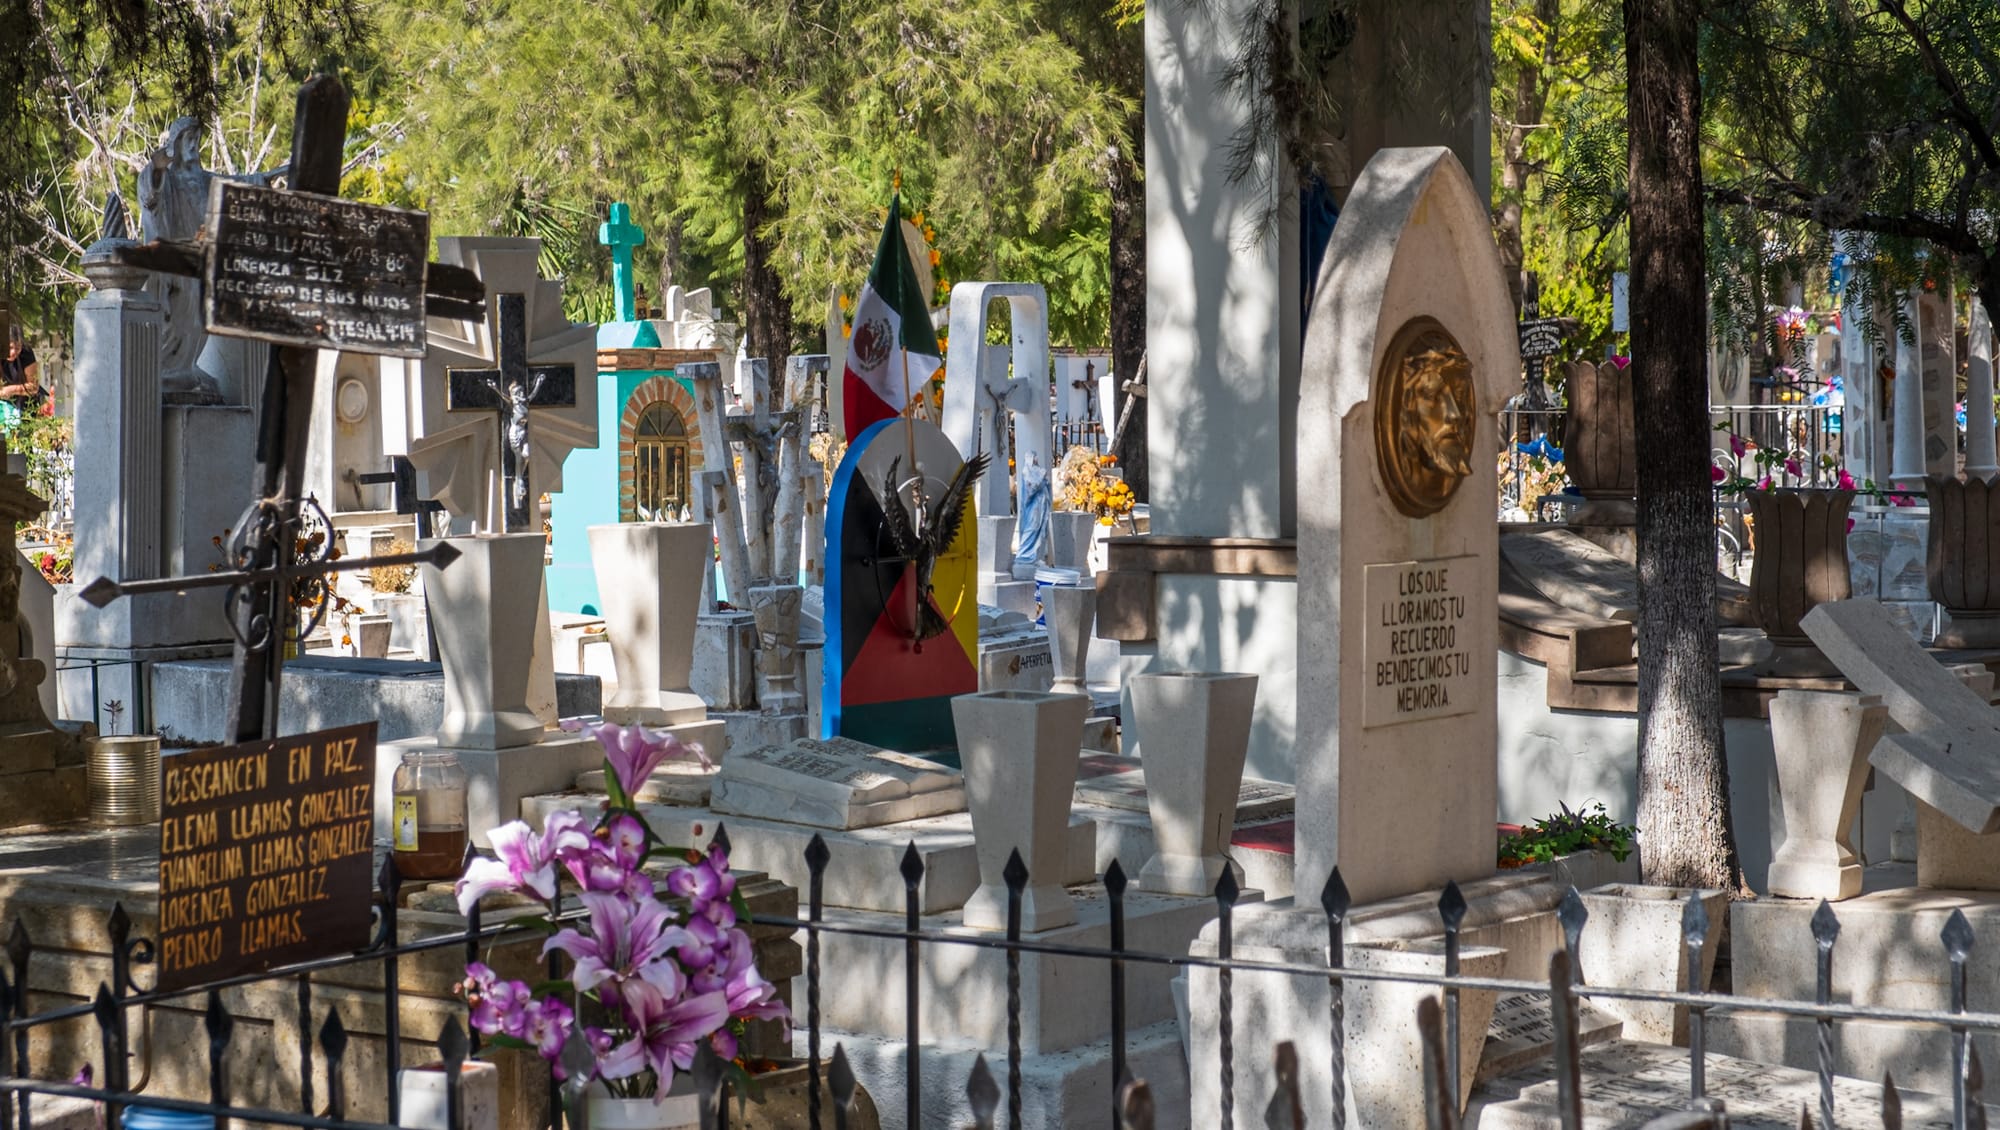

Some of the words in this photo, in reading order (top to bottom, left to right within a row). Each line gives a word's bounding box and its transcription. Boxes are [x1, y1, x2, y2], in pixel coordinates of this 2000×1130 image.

[228, 204, 267, 222] ELENA
[341, 206, 366, 220] LAS
[223, 258, 291, 277] LORENZA
[298, 286, 323, 303] DE
[324, 288, 356, 305] SUS
[362, 294, 411, 310] HIJOS
[1400, 570, 1424, 596] LOS
[1382, 597, 1447, 627] LLORAMOS
[1448, 595, 1465, 621] TU
[1391, 625, 1456, 656] RECUERDO
[1376, 653, 1452, 687] BENDECIMOS
[1454, 652, 1470, 677] TU
[165, 752, 268, 807] DESCANCEN
[287, 745, 312, 785] EN
[324, 736, 364, 777] PAZ.
[162, 810, 218, 854] ELENA
[230, 798, 293, 841] LLAMAS
[159, 845, 245, 895] EVANGELINA
[250, 834, 304, 877] LLAMAS
[159, 886, 234, 933] LORENZA
[245, 865, 330, 917] GONZALEZ.
[162, 925, 223, 972] PEDRO
[240, 909, 307, 956] LLAMAS.
